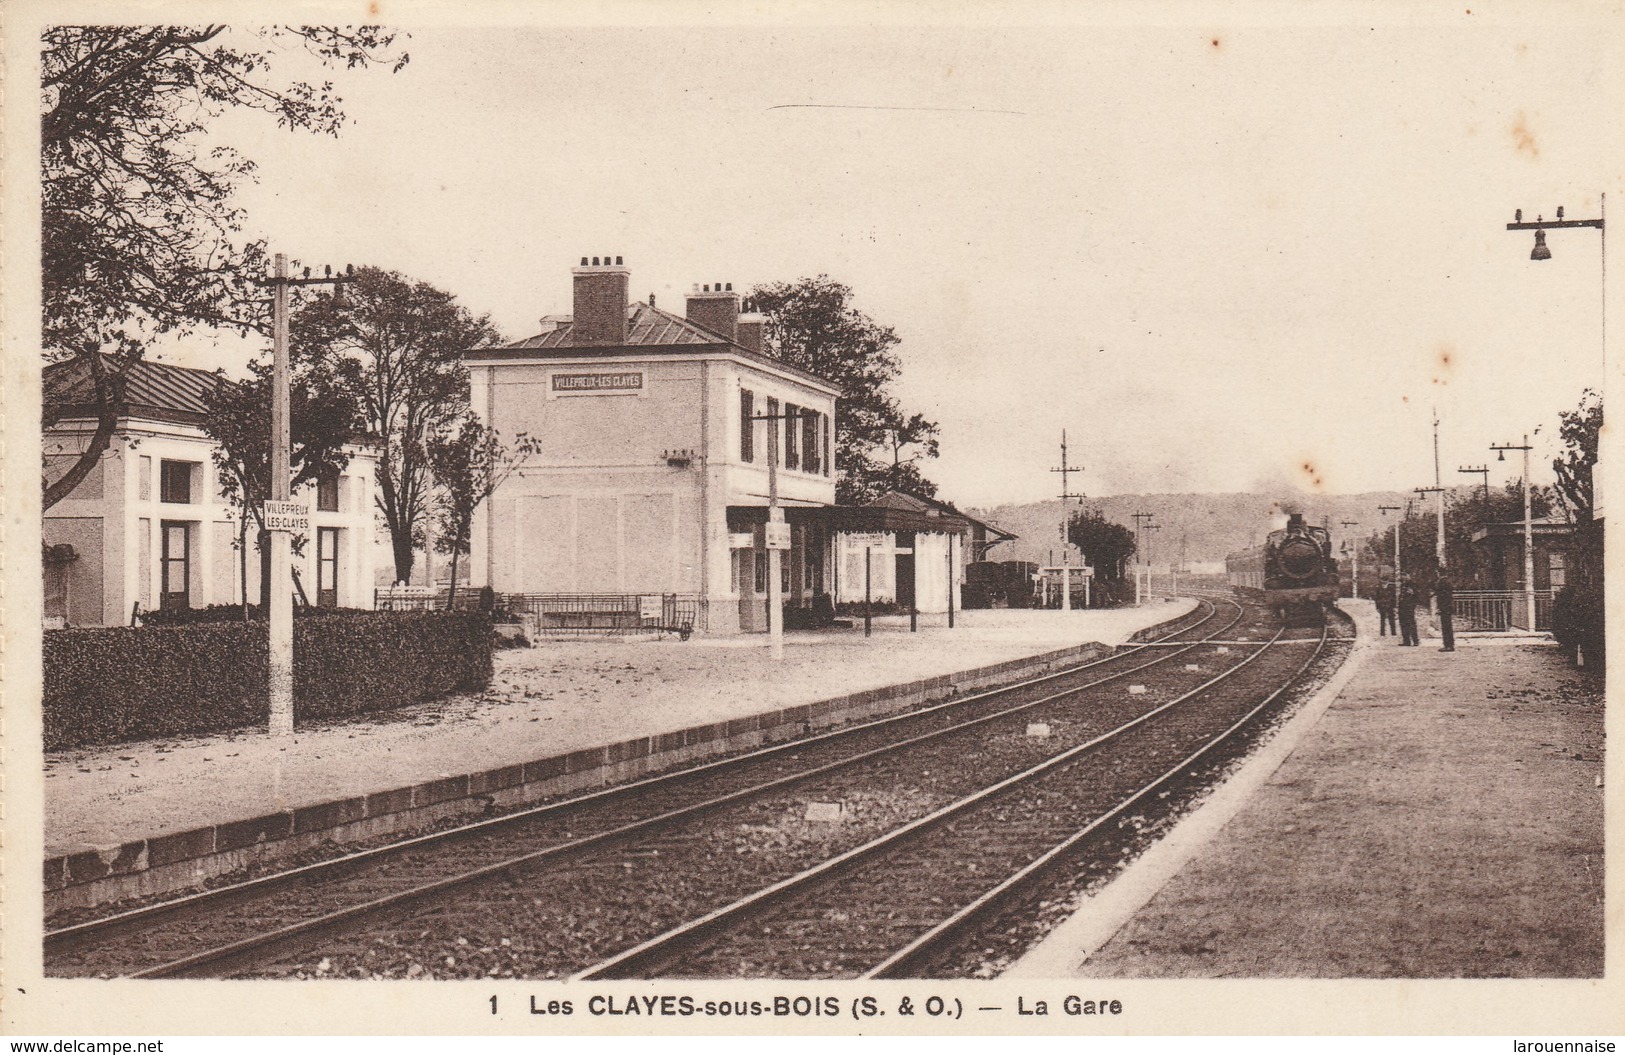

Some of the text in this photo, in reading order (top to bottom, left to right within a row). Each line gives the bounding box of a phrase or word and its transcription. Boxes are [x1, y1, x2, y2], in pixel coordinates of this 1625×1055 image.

[613, 375, 640, 387] CLAYES
[266, 503, 309, 515] VILLEPREUX
[267, 517, 309, 529] LES-CLAYES
